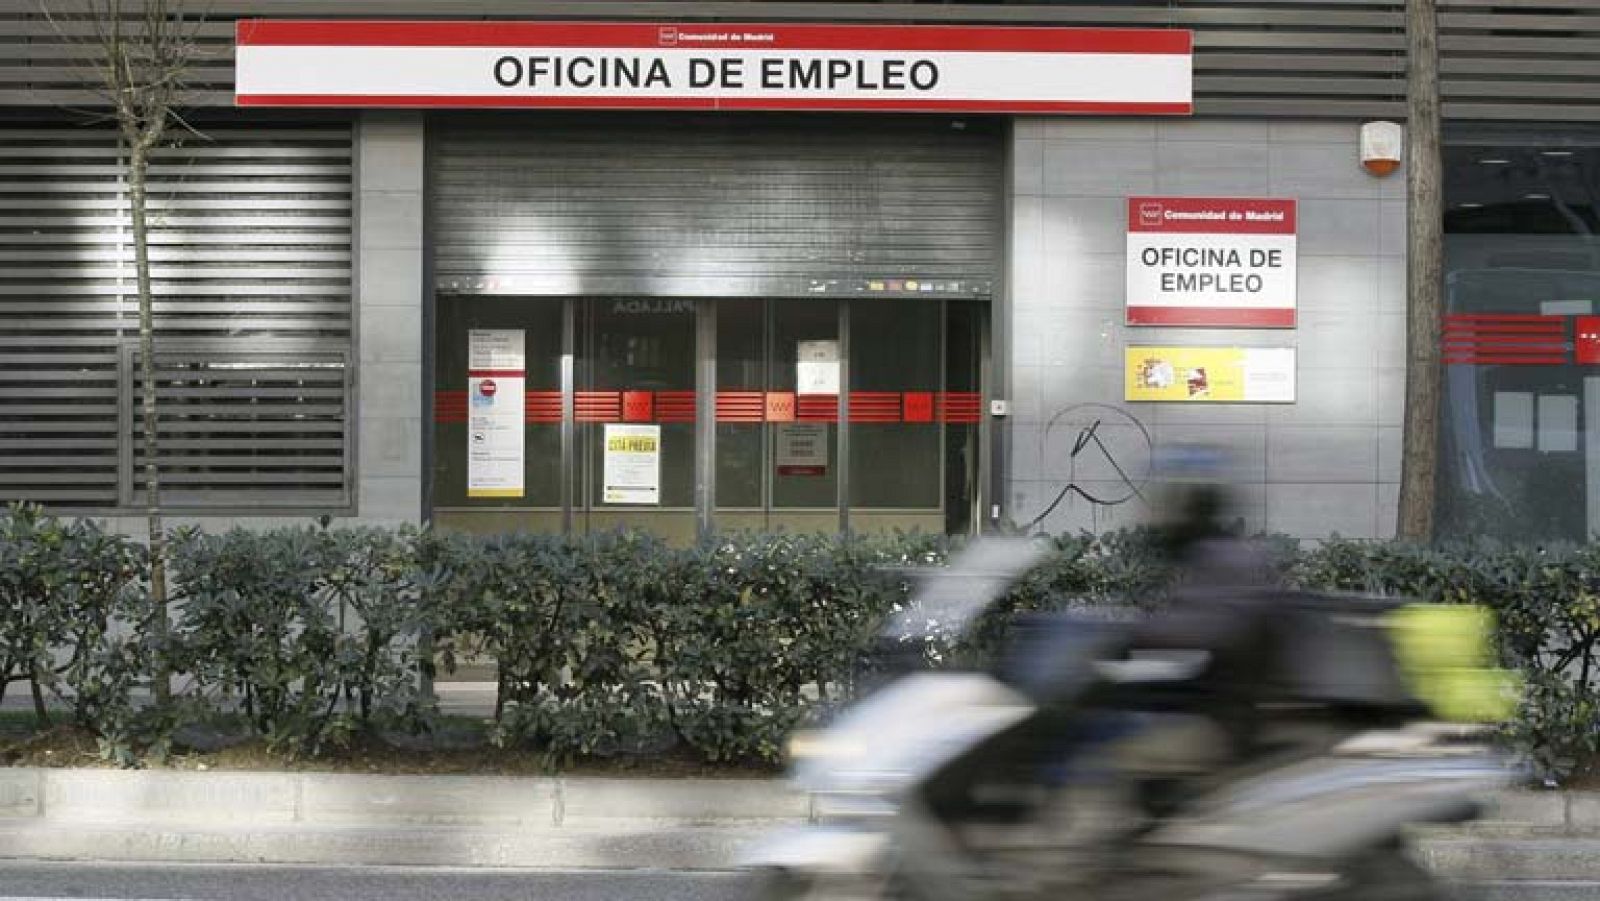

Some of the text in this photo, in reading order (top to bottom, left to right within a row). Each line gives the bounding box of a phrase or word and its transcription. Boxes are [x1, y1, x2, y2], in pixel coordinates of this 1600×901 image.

[678, 33, 774, 41] Comunidad de Madrid
[493, 55, 940, 91] OFICINA DE EMPLEO
[1163, 210, 1284, 221] Comunidad de Madrid
[1141, 248, 1282, 267] OFICINA DE
[1161, 273, 1263, 292] EMPLEO
